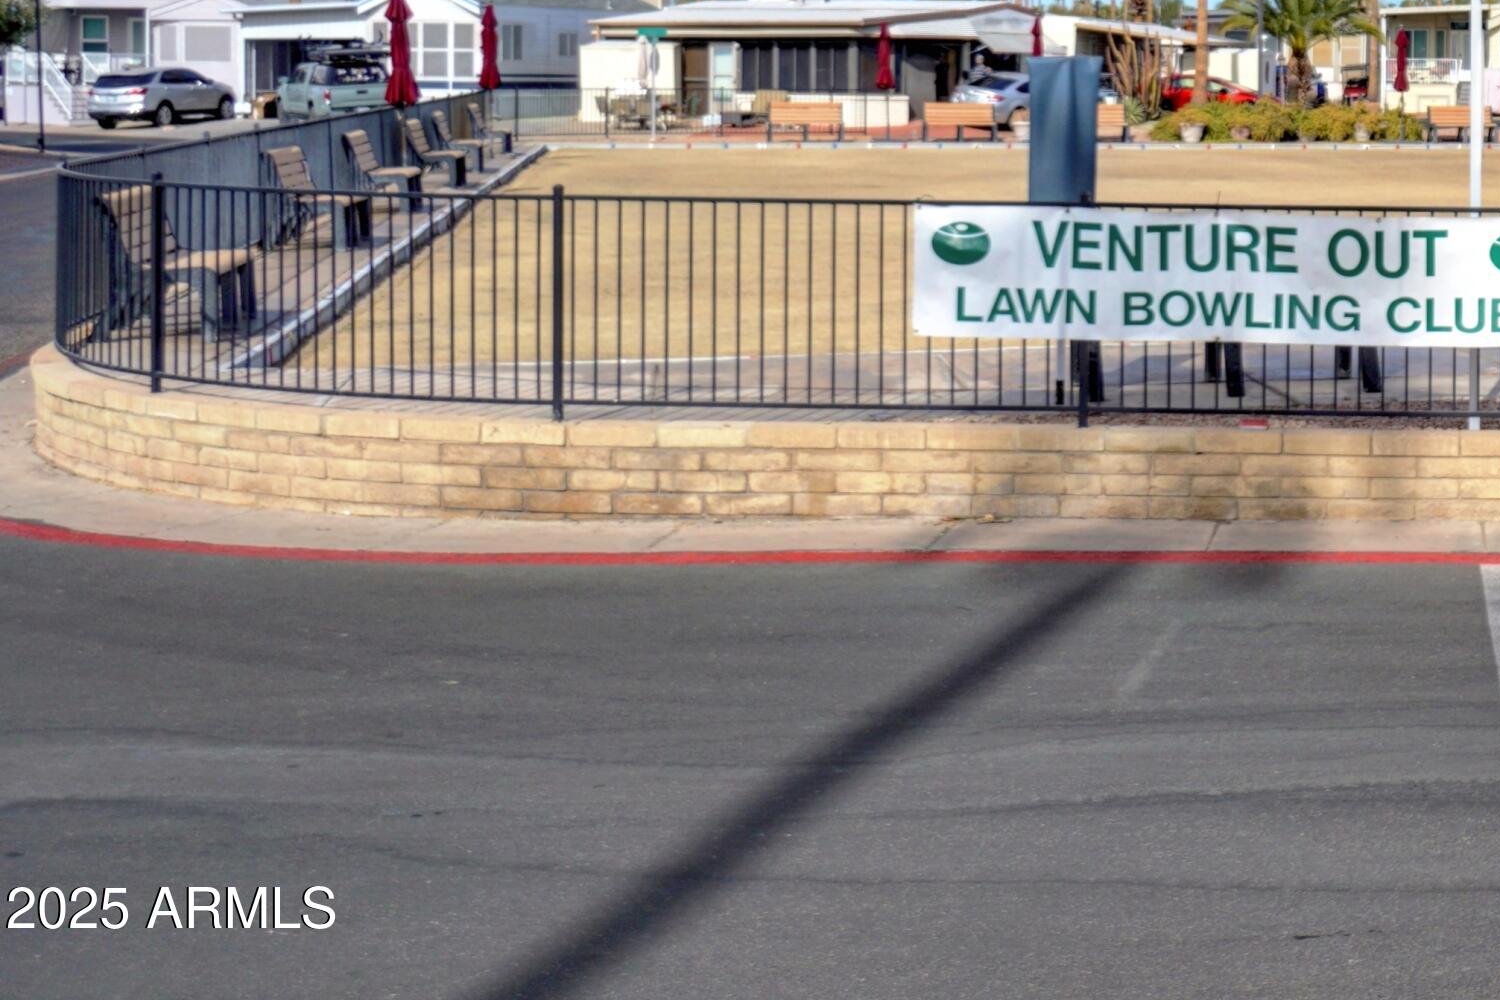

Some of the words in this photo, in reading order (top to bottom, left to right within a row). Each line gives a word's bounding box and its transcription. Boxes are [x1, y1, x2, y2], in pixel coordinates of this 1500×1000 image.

[1032, 220, 1299, 274] VENTURE
[1327, 228, 1449, 279] OUT
[956, 286, 1097, 325] LAWN
[1122, 290, 1361, 332] BOWLING
